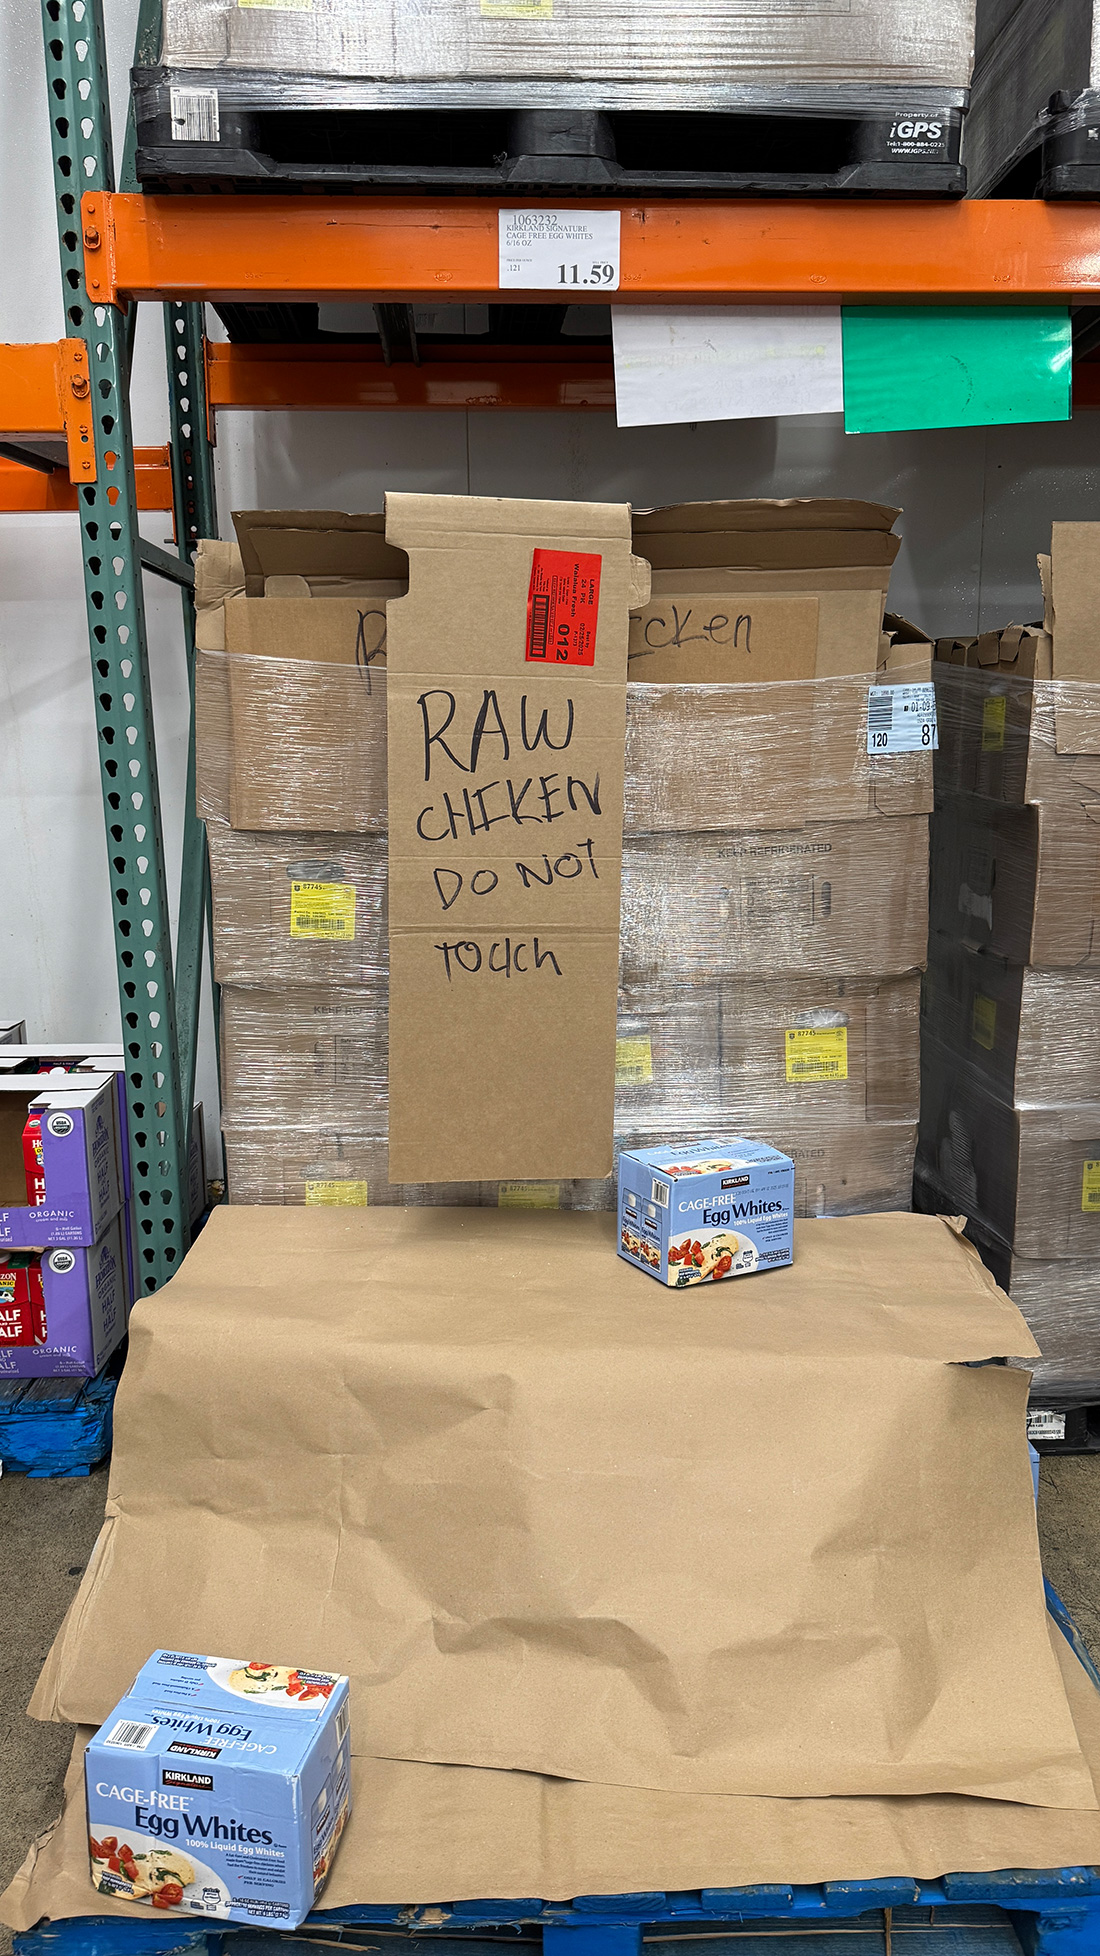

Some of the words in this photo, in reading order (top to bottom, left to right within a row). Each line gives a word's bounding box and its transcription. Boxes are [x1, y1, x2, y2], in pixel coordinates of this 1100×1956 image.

[889, 121, 942, 139] iGPS
[512, 214, 558, 226] 1063232
[545, 225, 588, 233] SIGNATURE
[548, 232, 564, 240] EGG
[557, 264, 615, 285] 11.59
[581, 579, 587, 589] 24
[580, 592, 586, 604] PK
[556, 624, 570, 661] 012
[416, 689, 574, 781] RAW
[872, 732, 888, 747] 120
[416, 772, 602, 840] CHIKEN
[433, 868, 498, 910] DO
[517, 838, 599, 888] NOT
[314, 1006, 341, 1015] KEEP
[722, 1175, 749, 1187] KIRKLAND
[678, 1193, 737, 1212] CAGE-FREE
[28, 1210, 75, 1219] ORGANIC
[702, 1208, 730, 1227] Egg
[732, 1199, 783, 1219] Whites
[733, 1218, 748, 1226] 100%
[748, 1215, 762, 1225] Liquid
[762, 1214, 772, 1223] Egg
[772, 1212, 789, 1220] Whites
[32, 1345, 77, 1355] ORGANIC
[151, 1709, 173, 1718] Whites
[153, 1716, 213, 1736] Whites
[215, 1723, 252, 1742] Egg
[169, 1744, 217, 1758] KIRKLAND
[205, 1736, 278, 1755] CAGE-FREE
[165, 1771, 212, 1785] KIRKLAND
[95, 1782, 190, 1812] CAGE-FREE
[135, 1805, 179, 1839] Egg
[182, 1813, 274, 1845] Whites
[185, 1838, 209, 1849] 100%
[210, 1841, 236, 1853] Liquid
[238, 1844, 254, 1856] Egg
[255, 1846, 285, 1858] Whites
